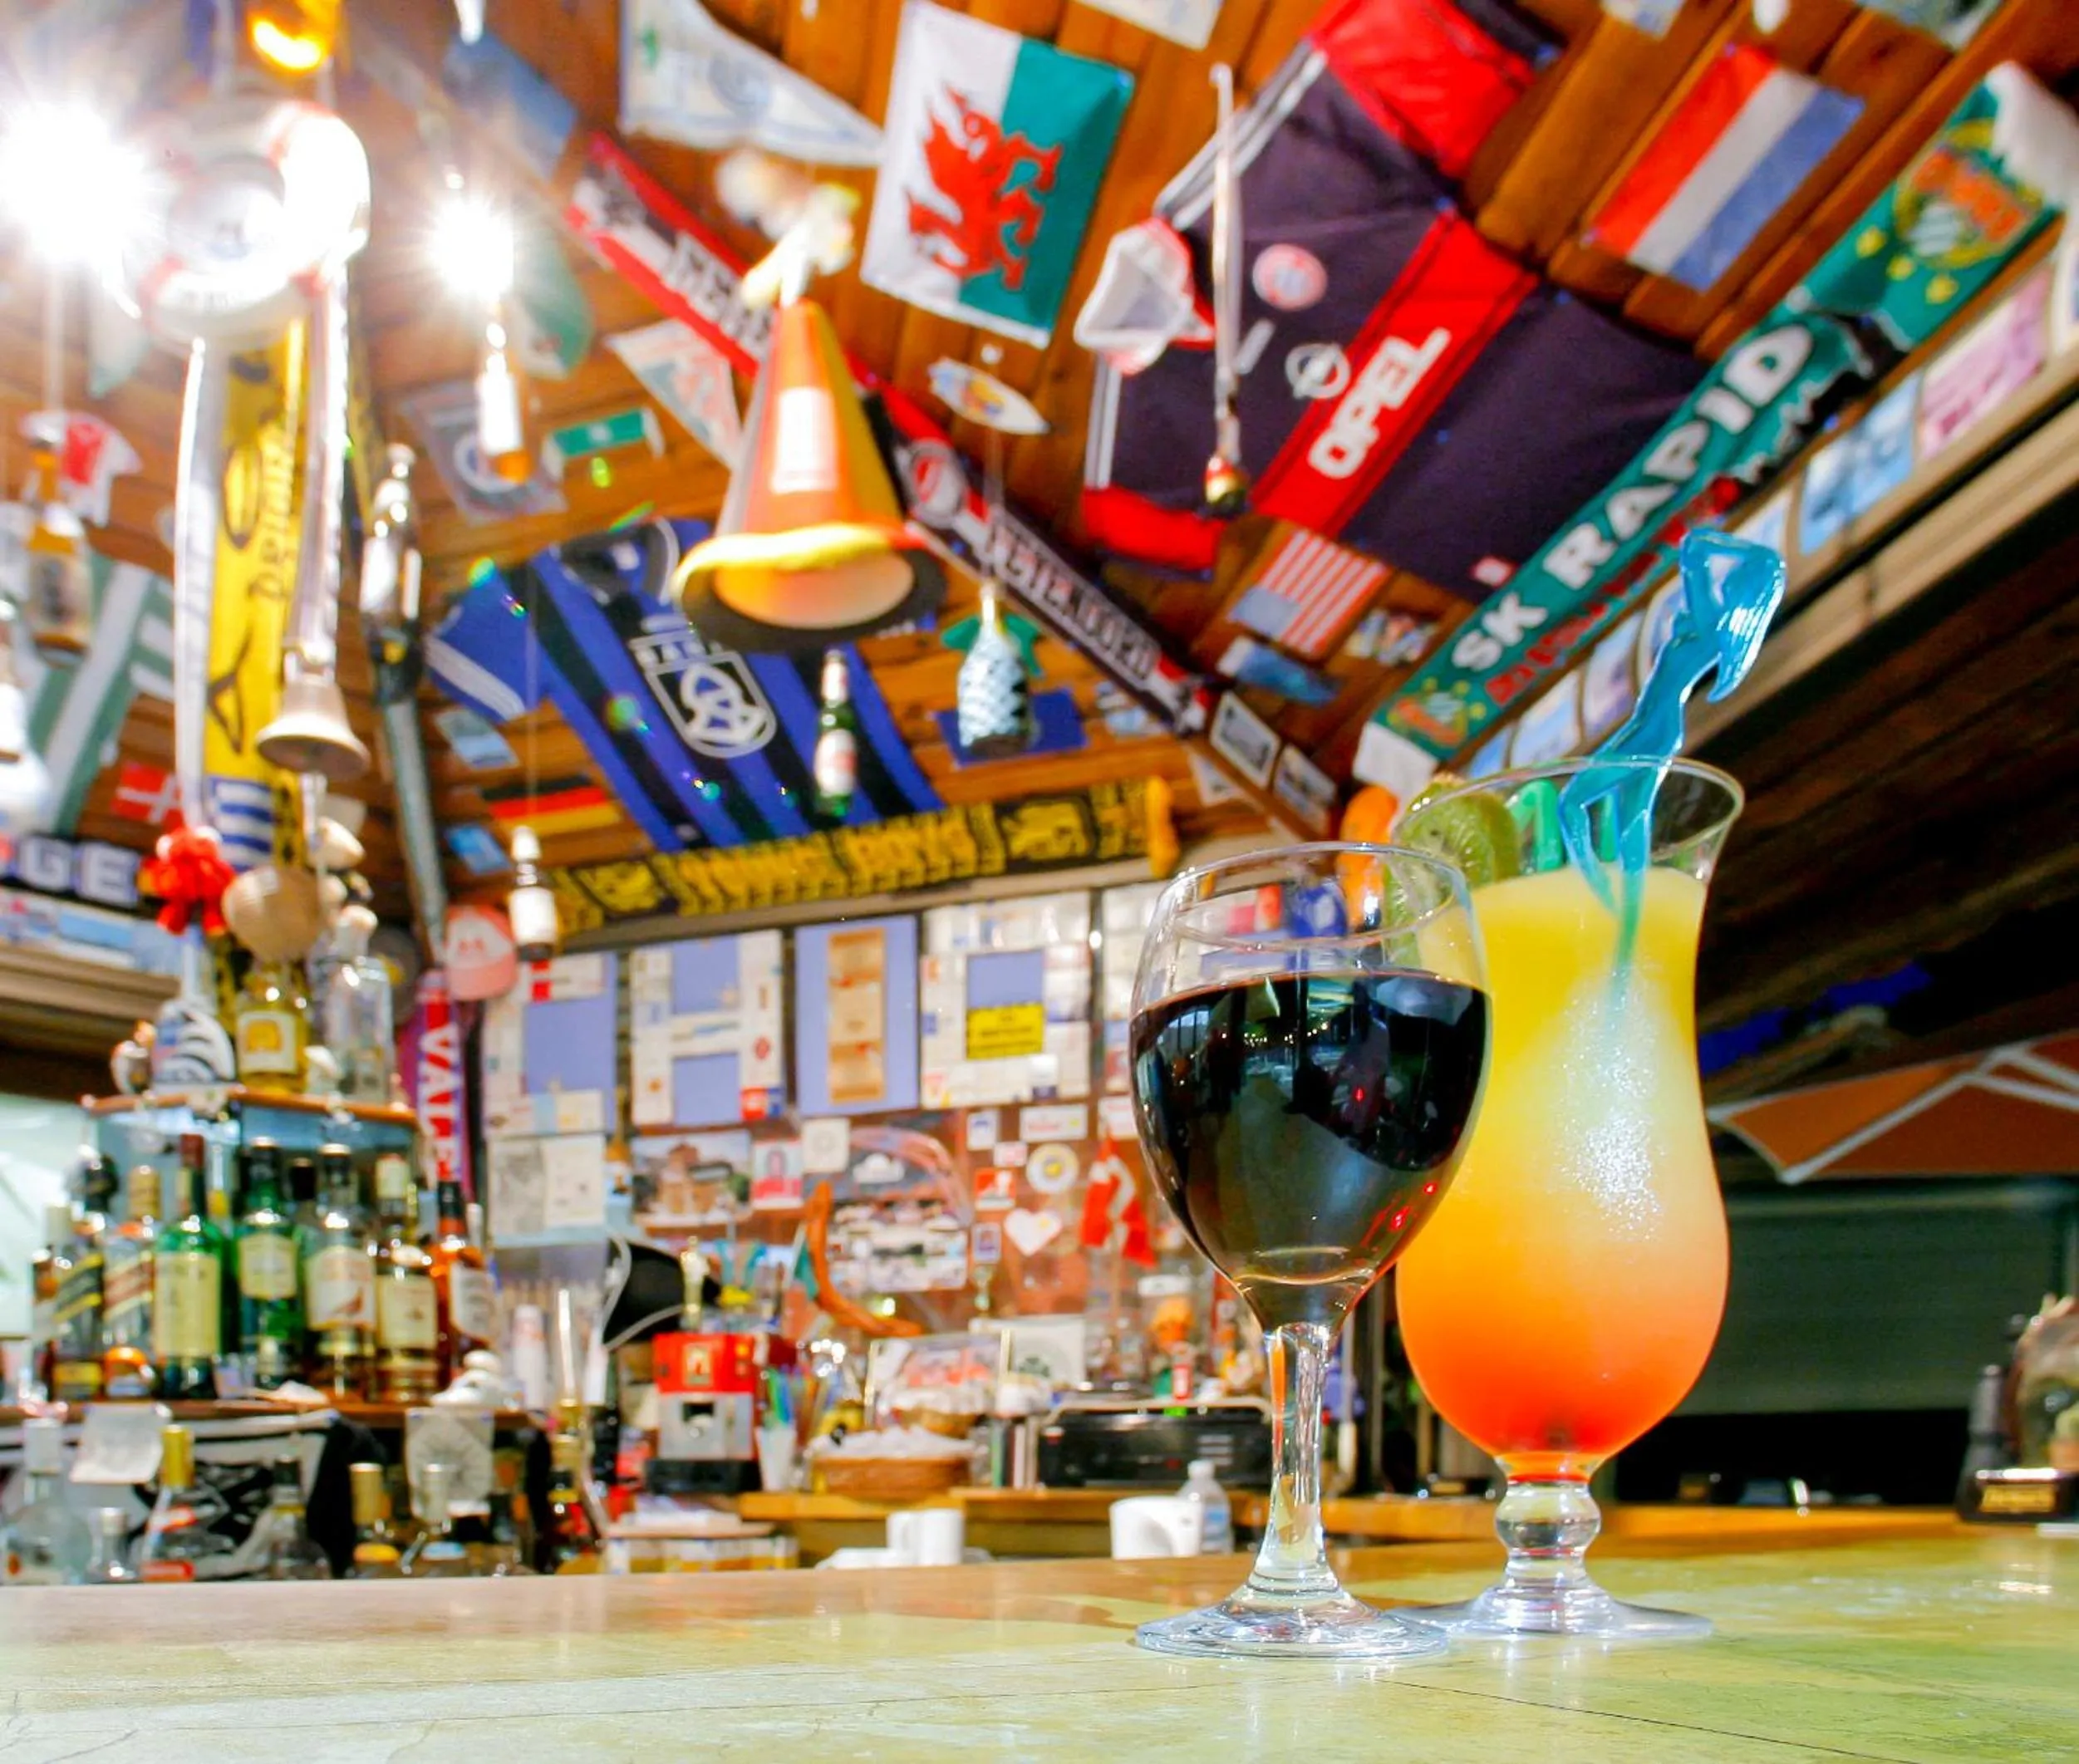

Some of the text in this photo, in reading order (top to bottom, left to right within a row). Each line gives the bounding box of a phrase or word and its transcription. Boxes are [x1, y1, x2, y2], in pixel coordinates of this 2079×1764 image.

[1306, 326, 1452, 480] OPEL
[1451, 592, 1549, 671] SK
[1543, 325, 1813, 590] RAPID
